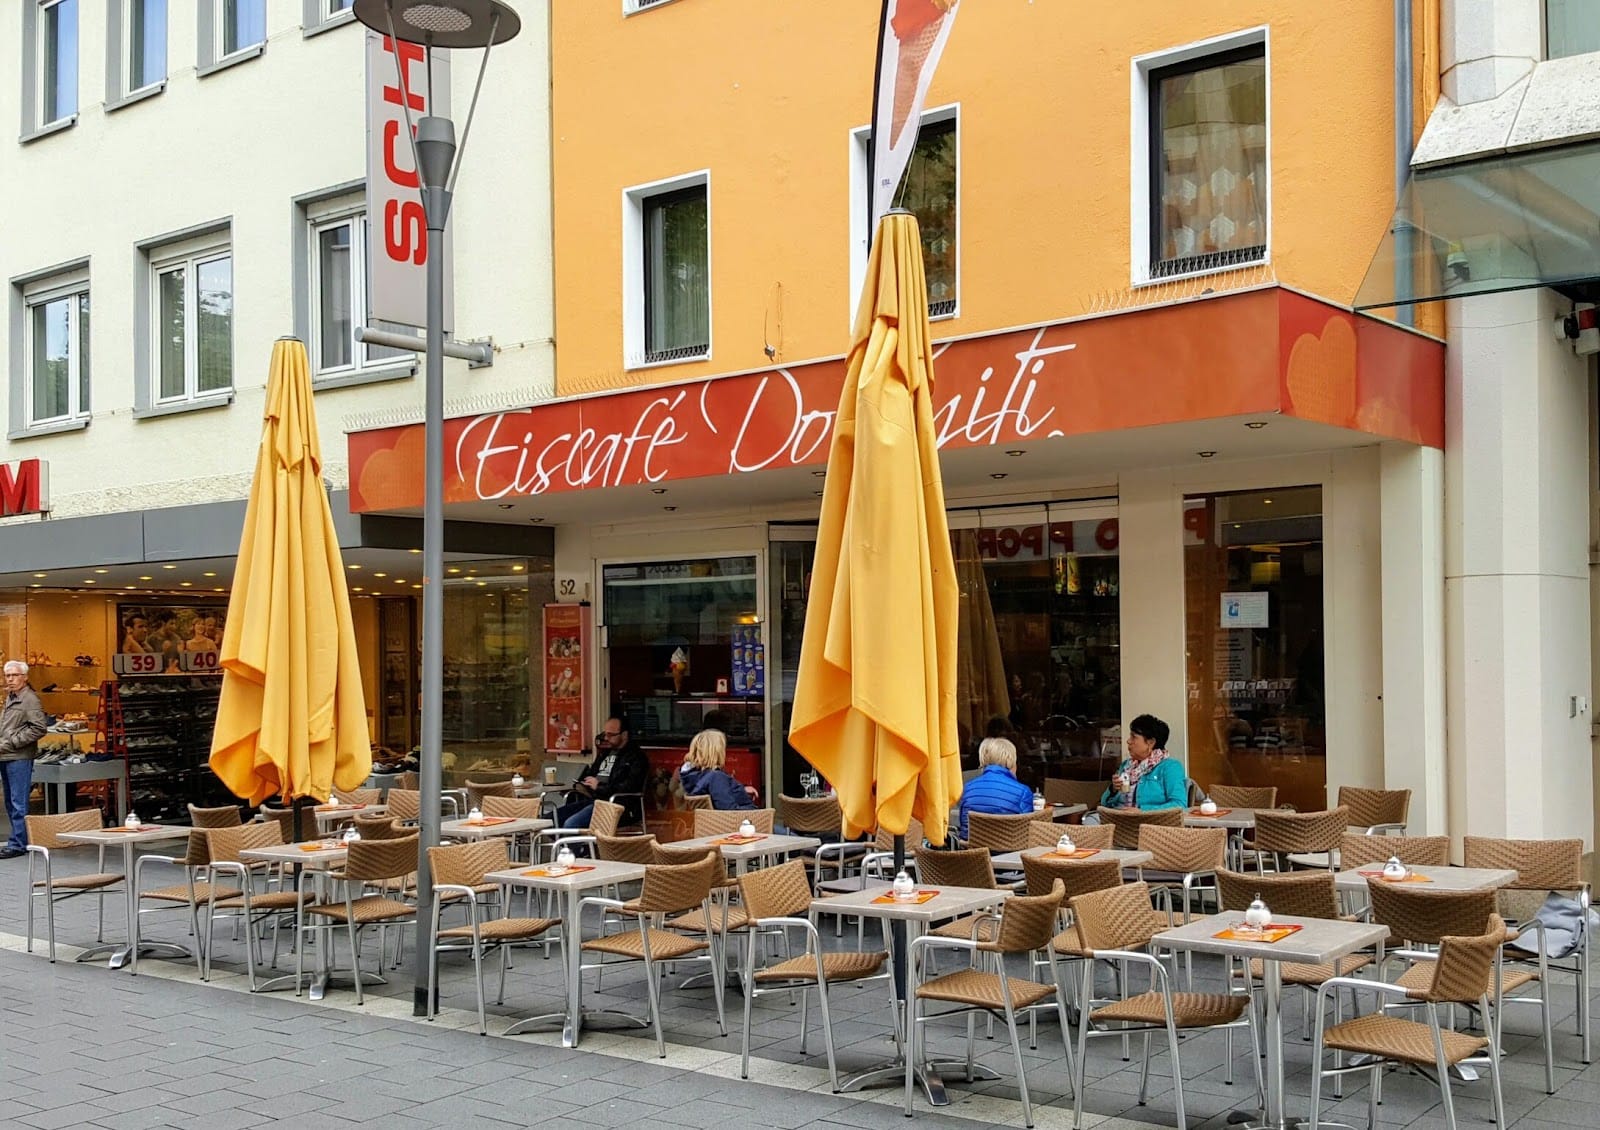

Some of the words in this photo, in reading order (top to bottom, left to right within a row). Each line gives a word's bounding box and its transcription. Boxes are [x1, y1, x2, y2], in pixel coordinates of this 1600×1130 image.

[456, 390, 688, 500] Eiscafé
[700, 327, 1076, 474] Doiti
[560, 579, 576, 596] 52
[131, 655, 156, 672] 39
[193, 652, 217, 669] 40
